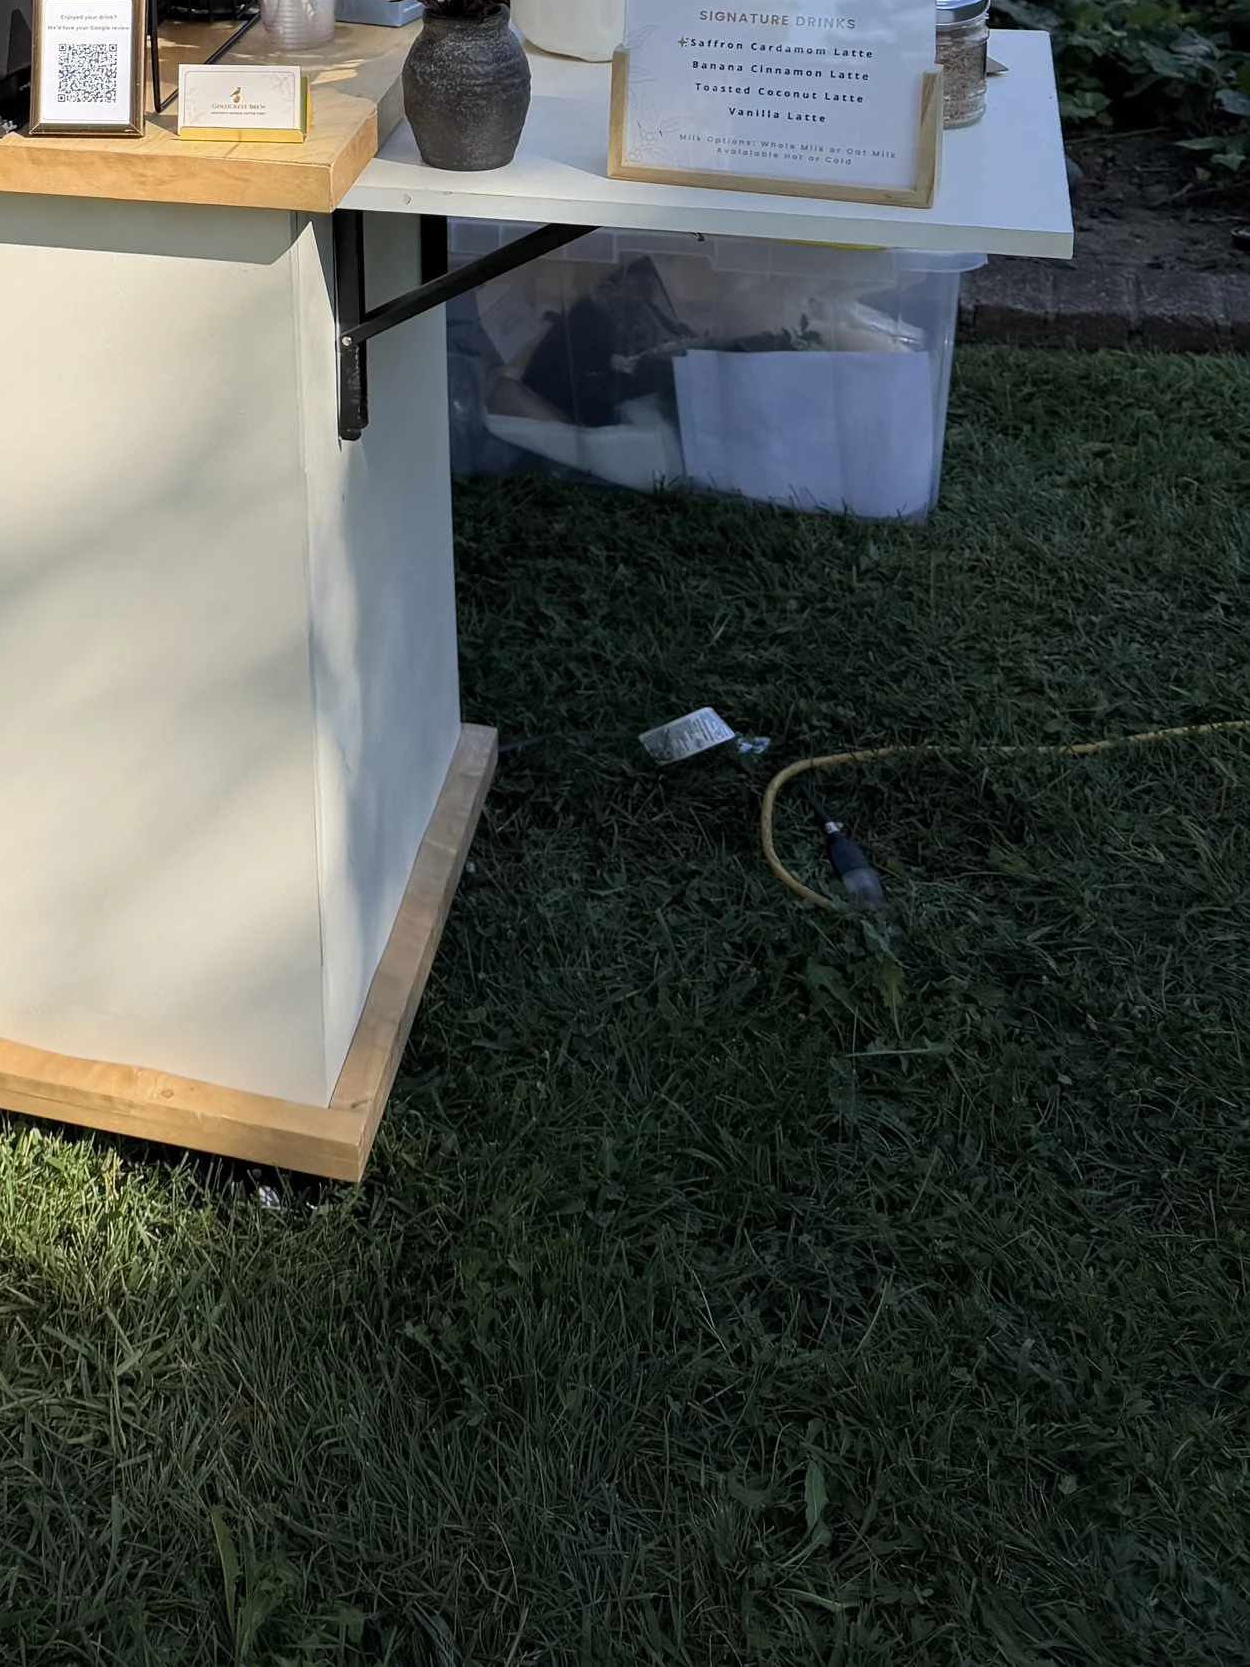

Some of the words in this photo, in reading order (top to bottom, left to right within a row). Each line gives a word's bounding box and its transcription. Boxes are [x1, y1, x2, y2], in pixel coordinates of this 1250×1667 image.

[699, 10, 789, 26] SIGNATURE
[795, 16, 856, 29] DRINKS
[690, 38, 743, 50] Saffron
[750, 42, 826, 55] Cardamom
[834, 48, 873, 59] Latte
[692, 61, 743, 72] Banana
[751, 65, 822, 78] Cinnamon
[830, 70, 869, 81] Latte
[695, 83, 750, 94] Toasted
[758, 87, 817, 99] Coconut
[825, 92, 863, 103] Latte
[729, 107, 780, 119] Vanilla
[787, 112, 826, 123] Latte
[679, 134, 701, 142] Milk
[707, 136, 755, 146] Options:
[760, 140, 795, 149] Whole
[800, 144, 824, 152] Milk
[846, 148, 867, 156] Oat
[872, 150, 896, 159] Milk
[825, 156, 851, 165] Cold
